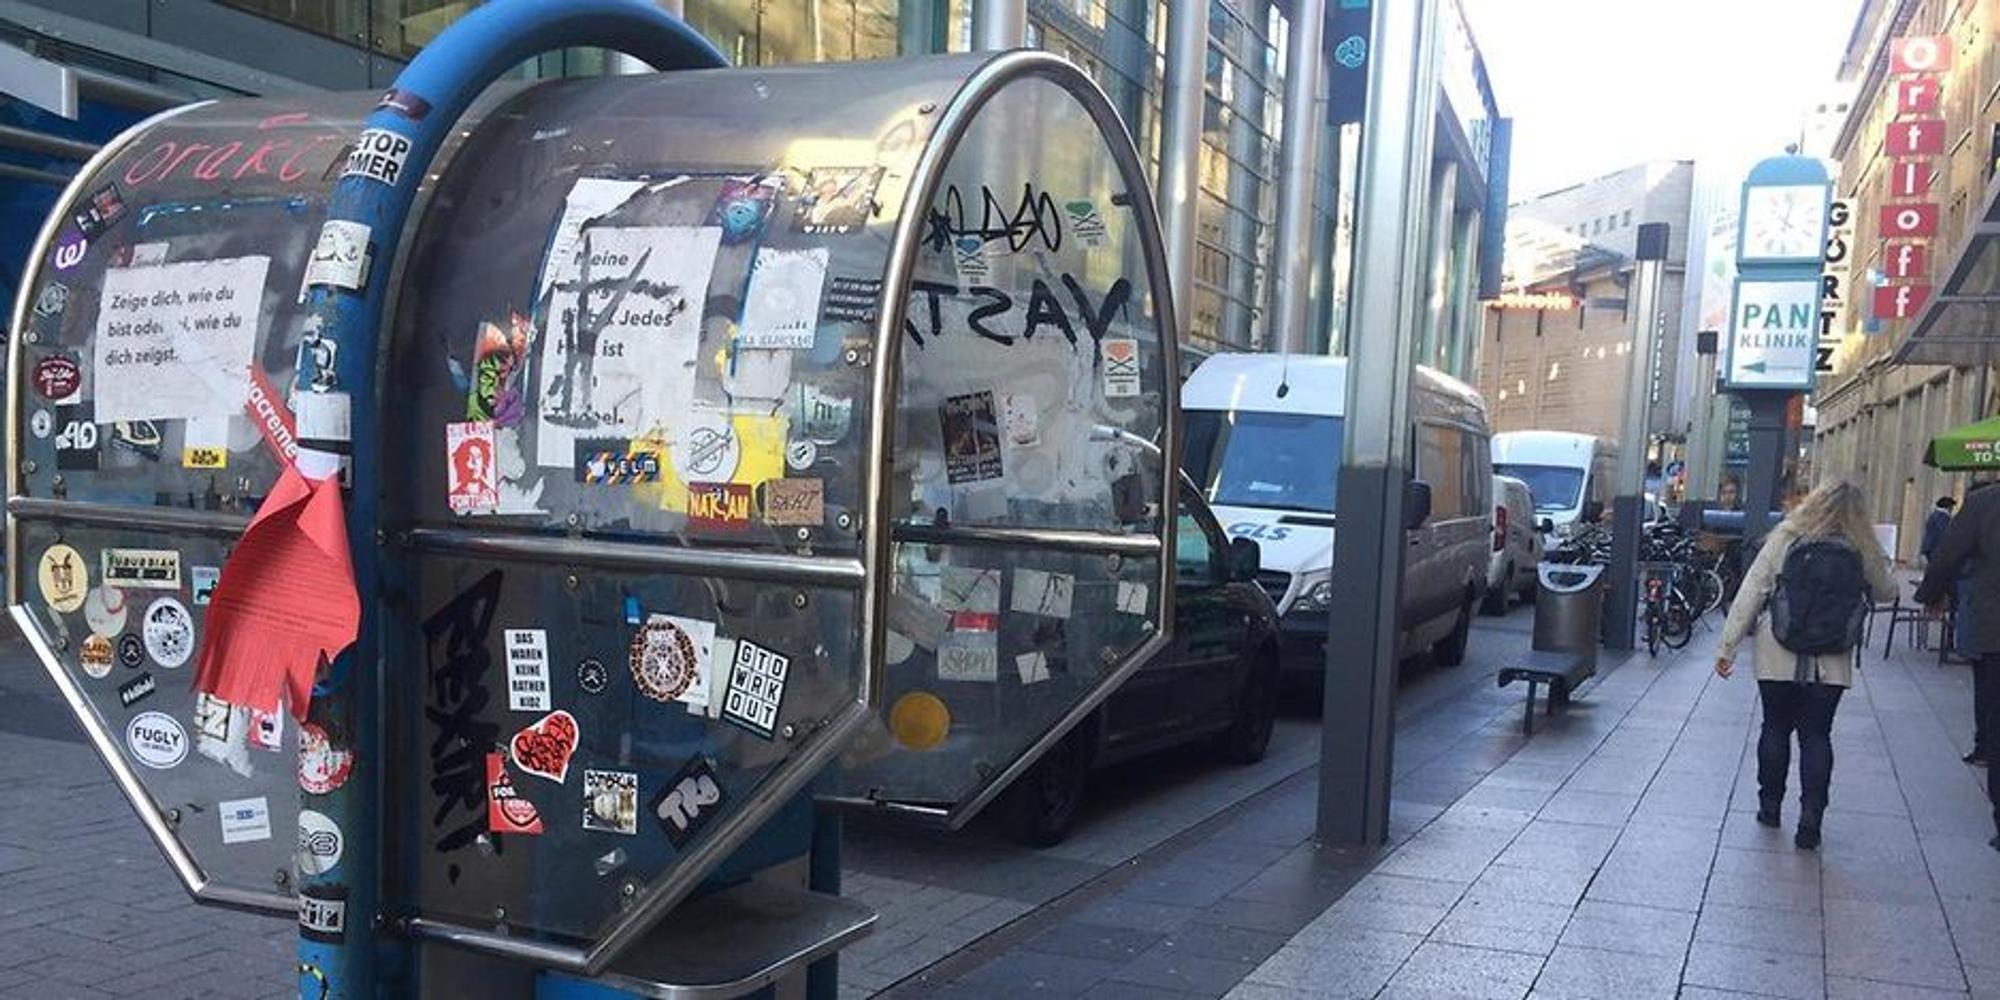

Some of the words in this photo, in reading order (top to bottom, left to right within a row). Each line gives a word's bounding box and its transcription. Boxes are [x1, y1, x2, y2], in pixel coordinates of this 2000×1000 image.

[357, 131, 409, 157] TOP
[345, 152, 399, 182] MER
[110, 293, 148, 312] Zeige
[151, 289, 183, 306] dich,
[187, 288, 213, 303] wie
[215, 285, 235, 301] du
[194, 313, 220, 330] wie
[223, 312, 242, 329] du
[619, 310, 674, 327] Jedes
[1742, 303, 1810, 329] PAN
[107, 321, 132, 338] bist
[602, 340, 625, 357] ist
[1739, 334, 1809, 348] KLINIK
[105, 348, 132, 366] dich
[135, 346, 179, 367] zeigst.
[1227, 522, 1292, 541] GLS
[514, 633, 535, 644] DAS
[510, 648, 543, 660] WAREN
[515, 664, 541, 677] KEINE
[133, 726, 181, 748] FUGLY
